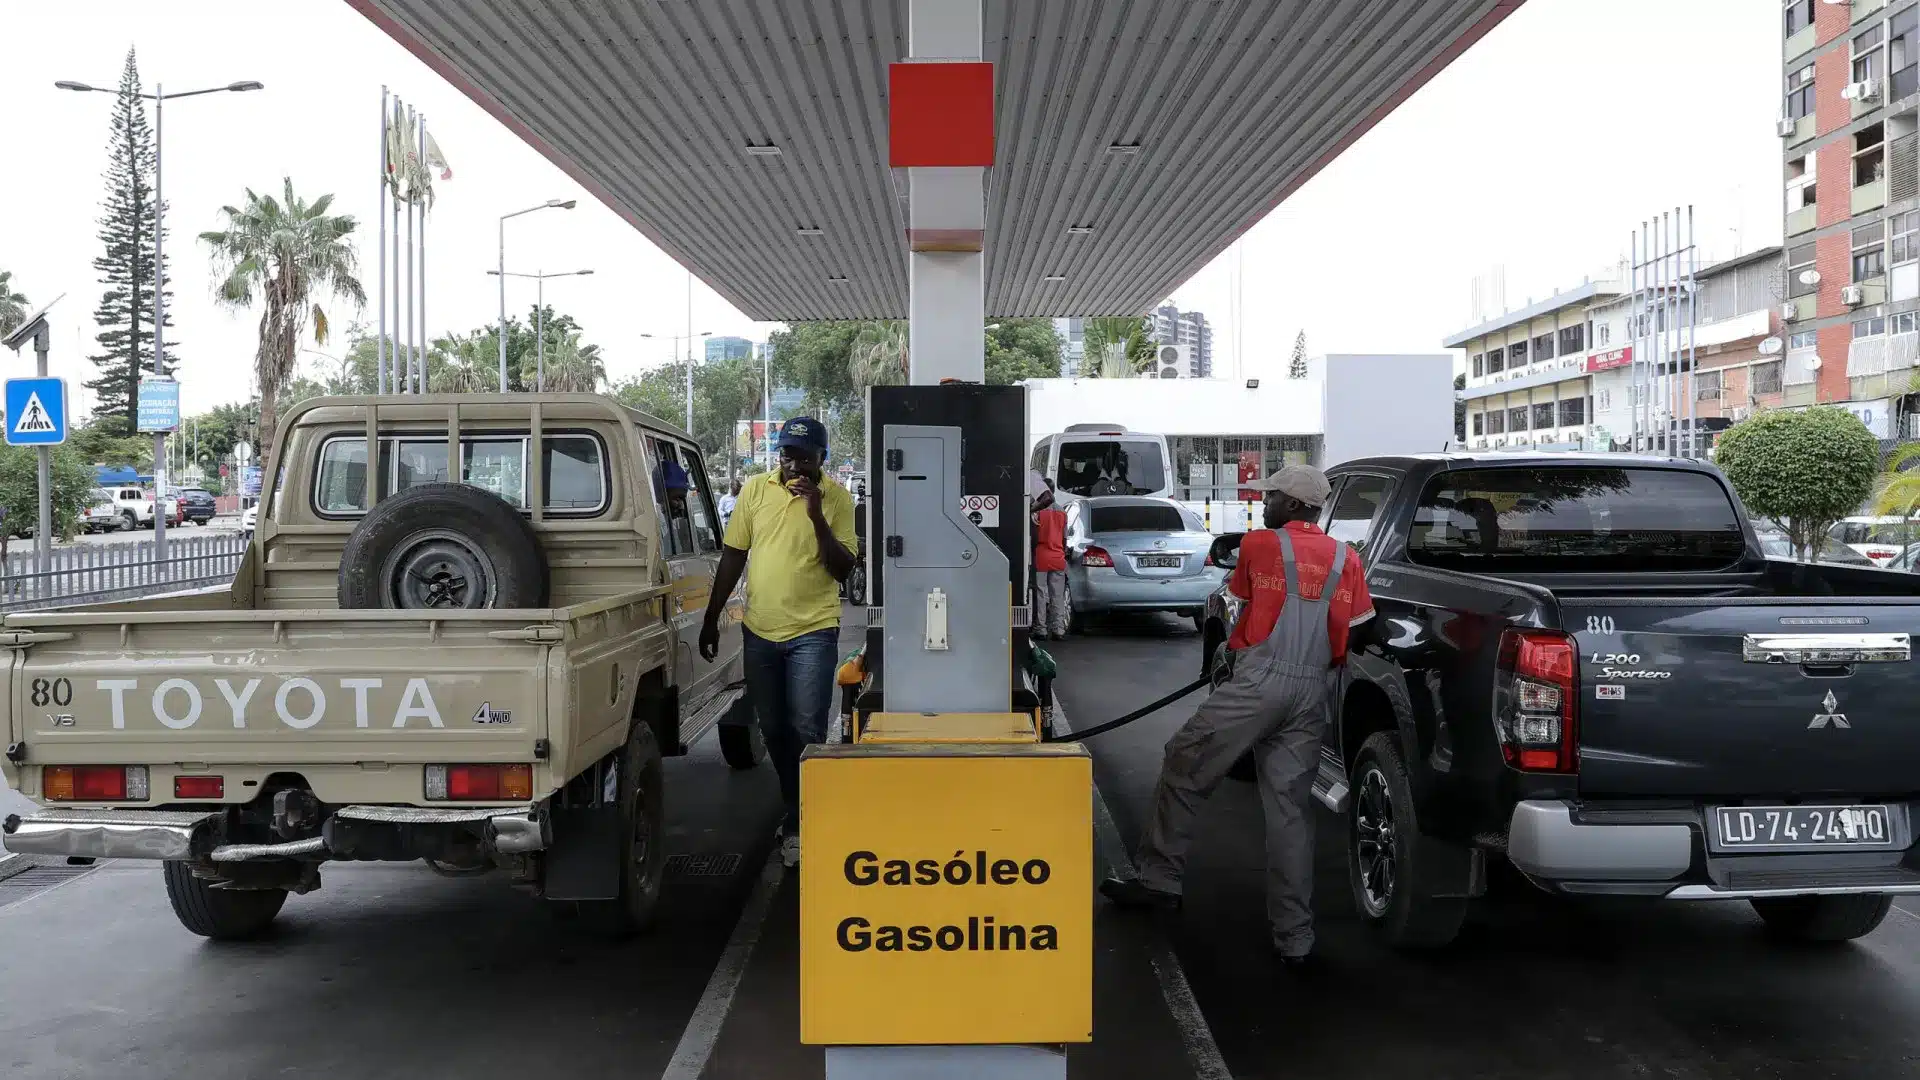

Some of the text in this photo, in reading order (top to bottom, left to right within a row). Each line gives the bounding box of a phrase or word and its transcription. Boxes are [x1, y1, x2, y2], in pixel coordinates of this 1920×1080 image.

[1586, 615, 1614, 635] 80
[1591, 652, 1640, 665] L200
[1595, 666, 1671, 681] Sportero
[31, 677, 72, 707] 80
[96, 678, 445, 729] TOYOTA
[472, 701, 512, 724] 4WD
[1723, 810, 1883, 842] LD-74-24HQ
[844, 850, 1051, 886] Gasóleo
[836, 916, 1058, 952] Gasolina
